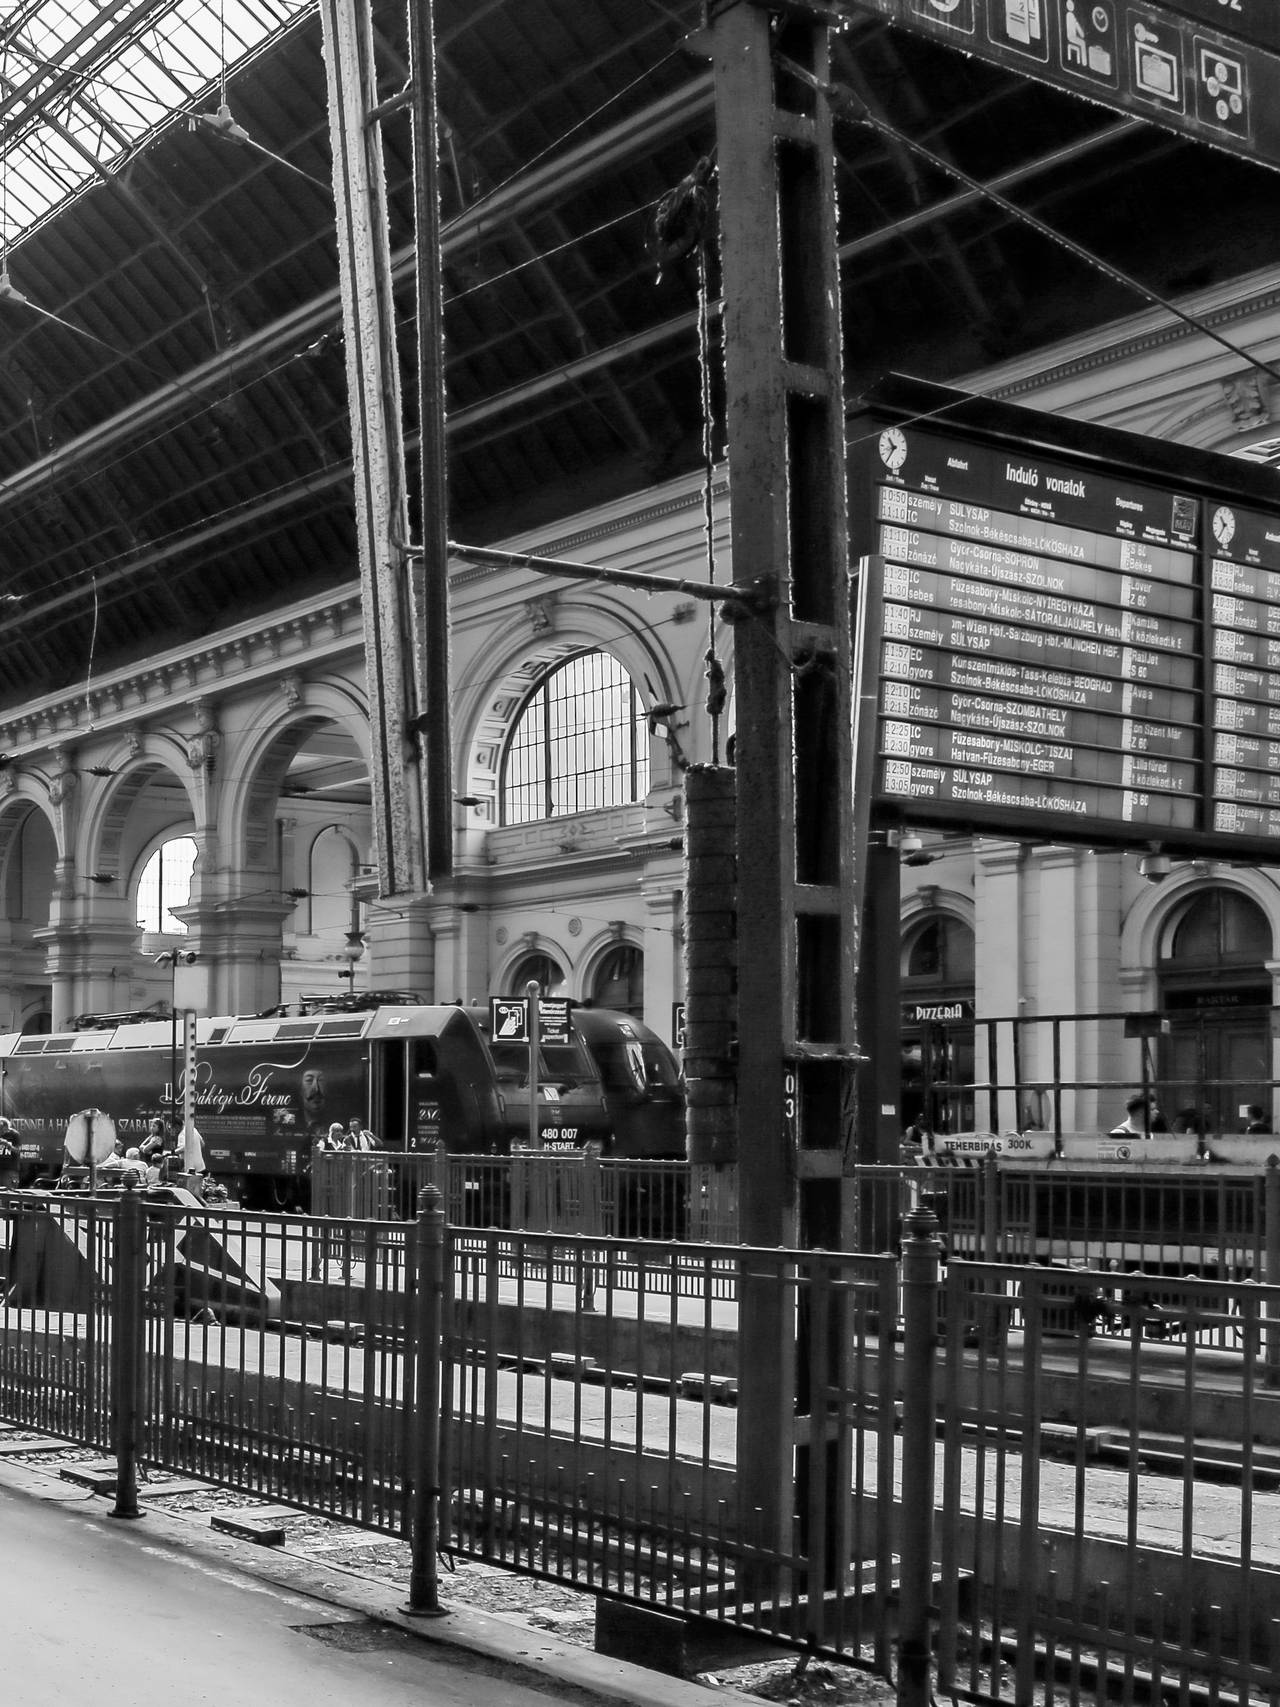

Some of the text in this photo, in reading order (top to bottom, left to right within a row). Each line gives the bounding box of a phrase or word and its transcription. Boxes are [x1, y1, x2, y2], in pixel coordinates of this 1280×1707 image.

[1006, 463, 1086, 498] Induló vonatok
[883, 489, 906, 504] 10:50
[883, 504, 906, 520] 11:10
[907, 509, 918, 523] IC
[909, 532, 919, 545] IC
[884, 566, 908, 582] 11:25
[909, 571, 920, 584] IC
[909, 589, 934, 602] sebes
[910, 610, 921, 623] RJ
[884, 621, 908, 637] 11:50
[885, 643, 909, 658] 11:57
[910, 648, 922, 661] EC
[884, 661, 908, 676] 12:10
[909, 666, 933, 680] gyors
[885, 683, 909, 698] 12:10
[910, 688, 920, 700] IC
[885, 699, 908, 715] 12:15
[886, 721, 909, 737] 12:25
[910, 727, 921, 738] IC
[885, 738, 909, 753] 12:30
[910, 744, 933, 757] gyors
[887, 761, 910, 776] 12:50
[886, 777, 910, 793] 13:05
[910, 783, 934, 796] gyors
[916, 1004, 963, 1021] PIZZERIA
[411, 1137, 417, 1147] 2
[542, 1128, 578, 1140] 480 007
[544, 1142, 575, 1151] H-START
[944, 1139, 1002, 1153] TEHERBÍRÁS
